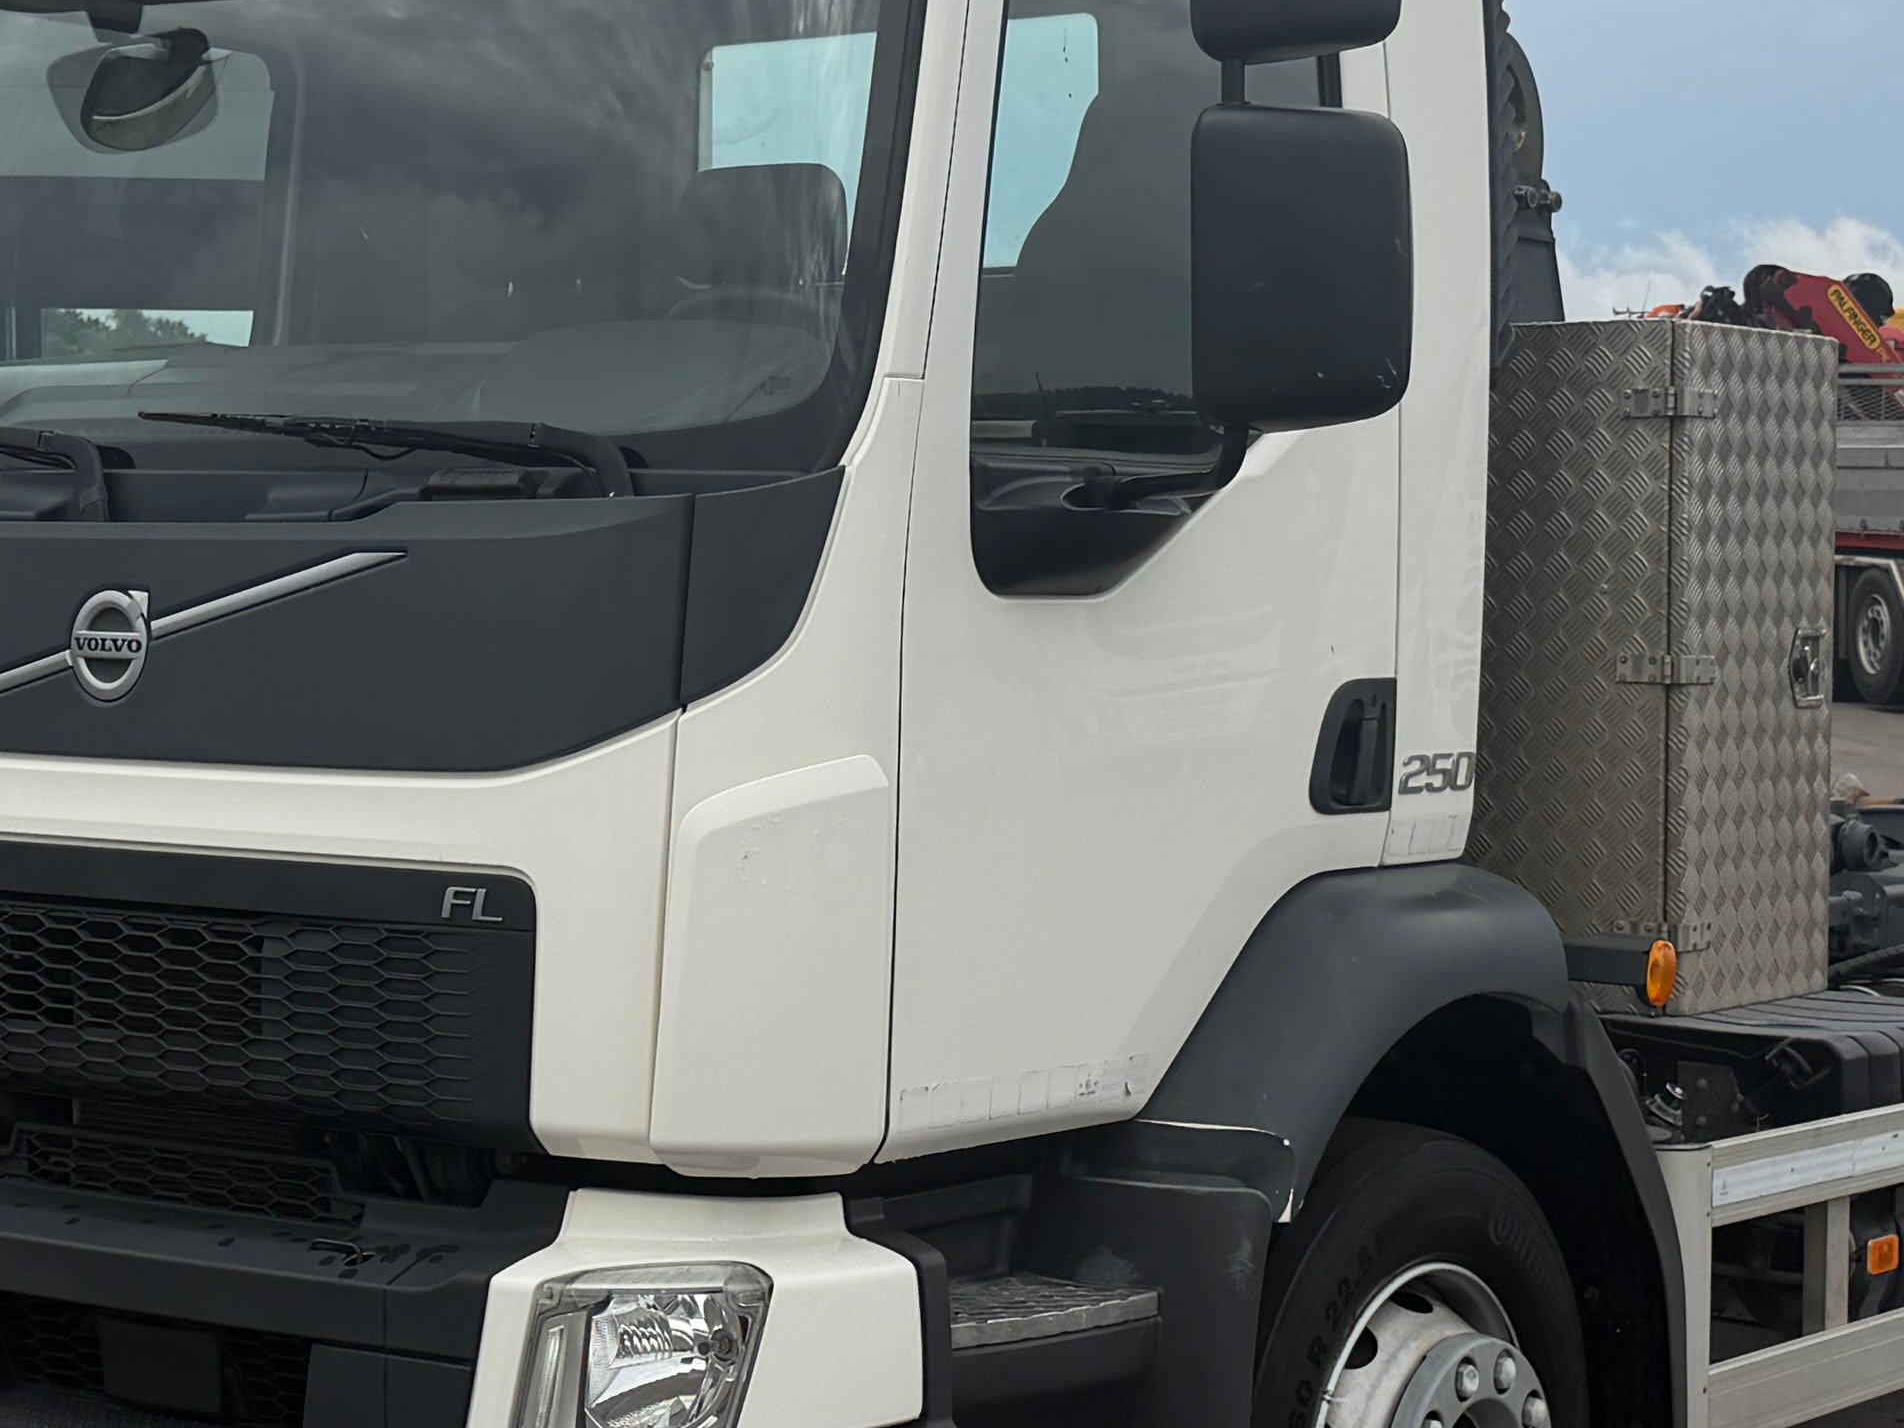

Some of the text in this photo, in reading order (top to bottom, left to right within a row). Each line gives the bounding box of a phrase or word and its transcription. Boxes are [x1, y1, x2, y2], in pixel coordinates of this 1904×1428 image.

[1829, 287, 1877, 347] PALFINGER
[75, 636, 142, 654] VOLVO
[1398, 751, 1476, 795] 250
[441, 886, 503, 921] FL
[1305, 1334, 1328, 1371] R
[1324, 1244, 1374, 1331] 22.5
